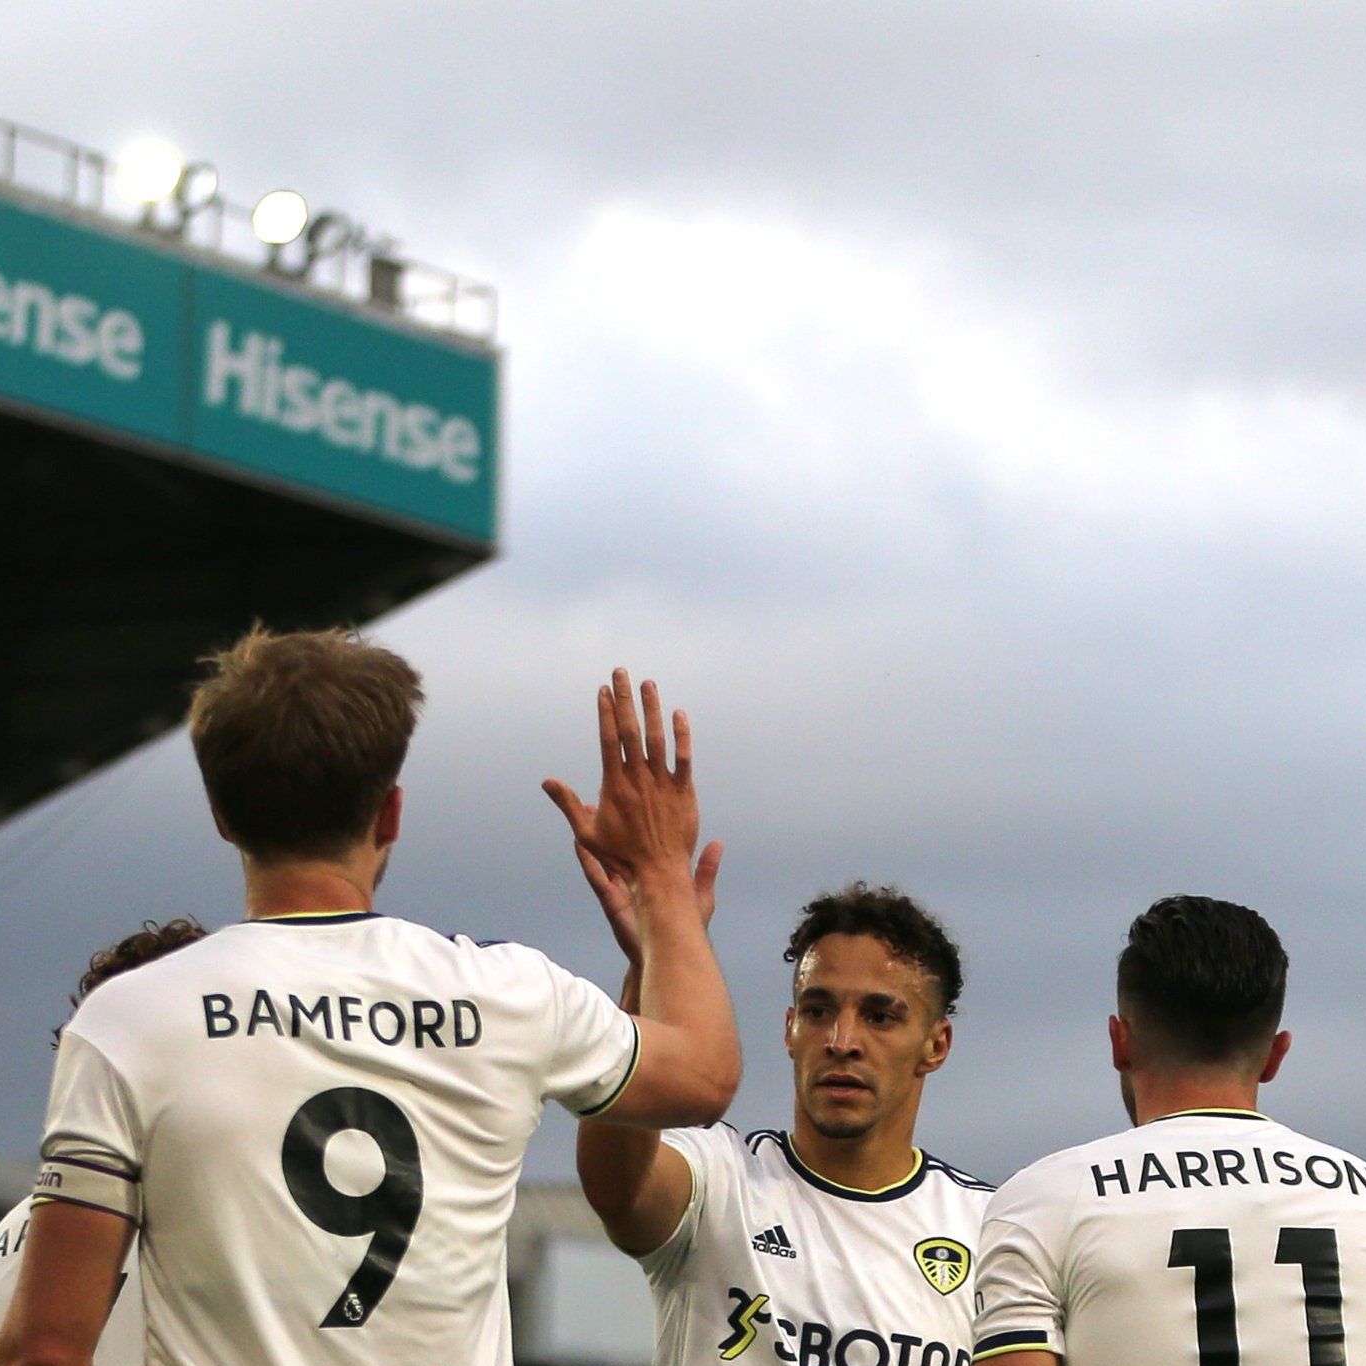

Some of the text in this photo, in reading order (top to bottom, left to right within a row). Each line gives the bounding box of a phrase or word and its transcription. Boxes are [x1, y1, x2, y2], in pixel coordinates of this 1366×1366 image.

[204, 319, 481, 482] Hisense
[202, 989, 482, 1049] BAMFORD
[281, 1086, 423, 1329] 9
